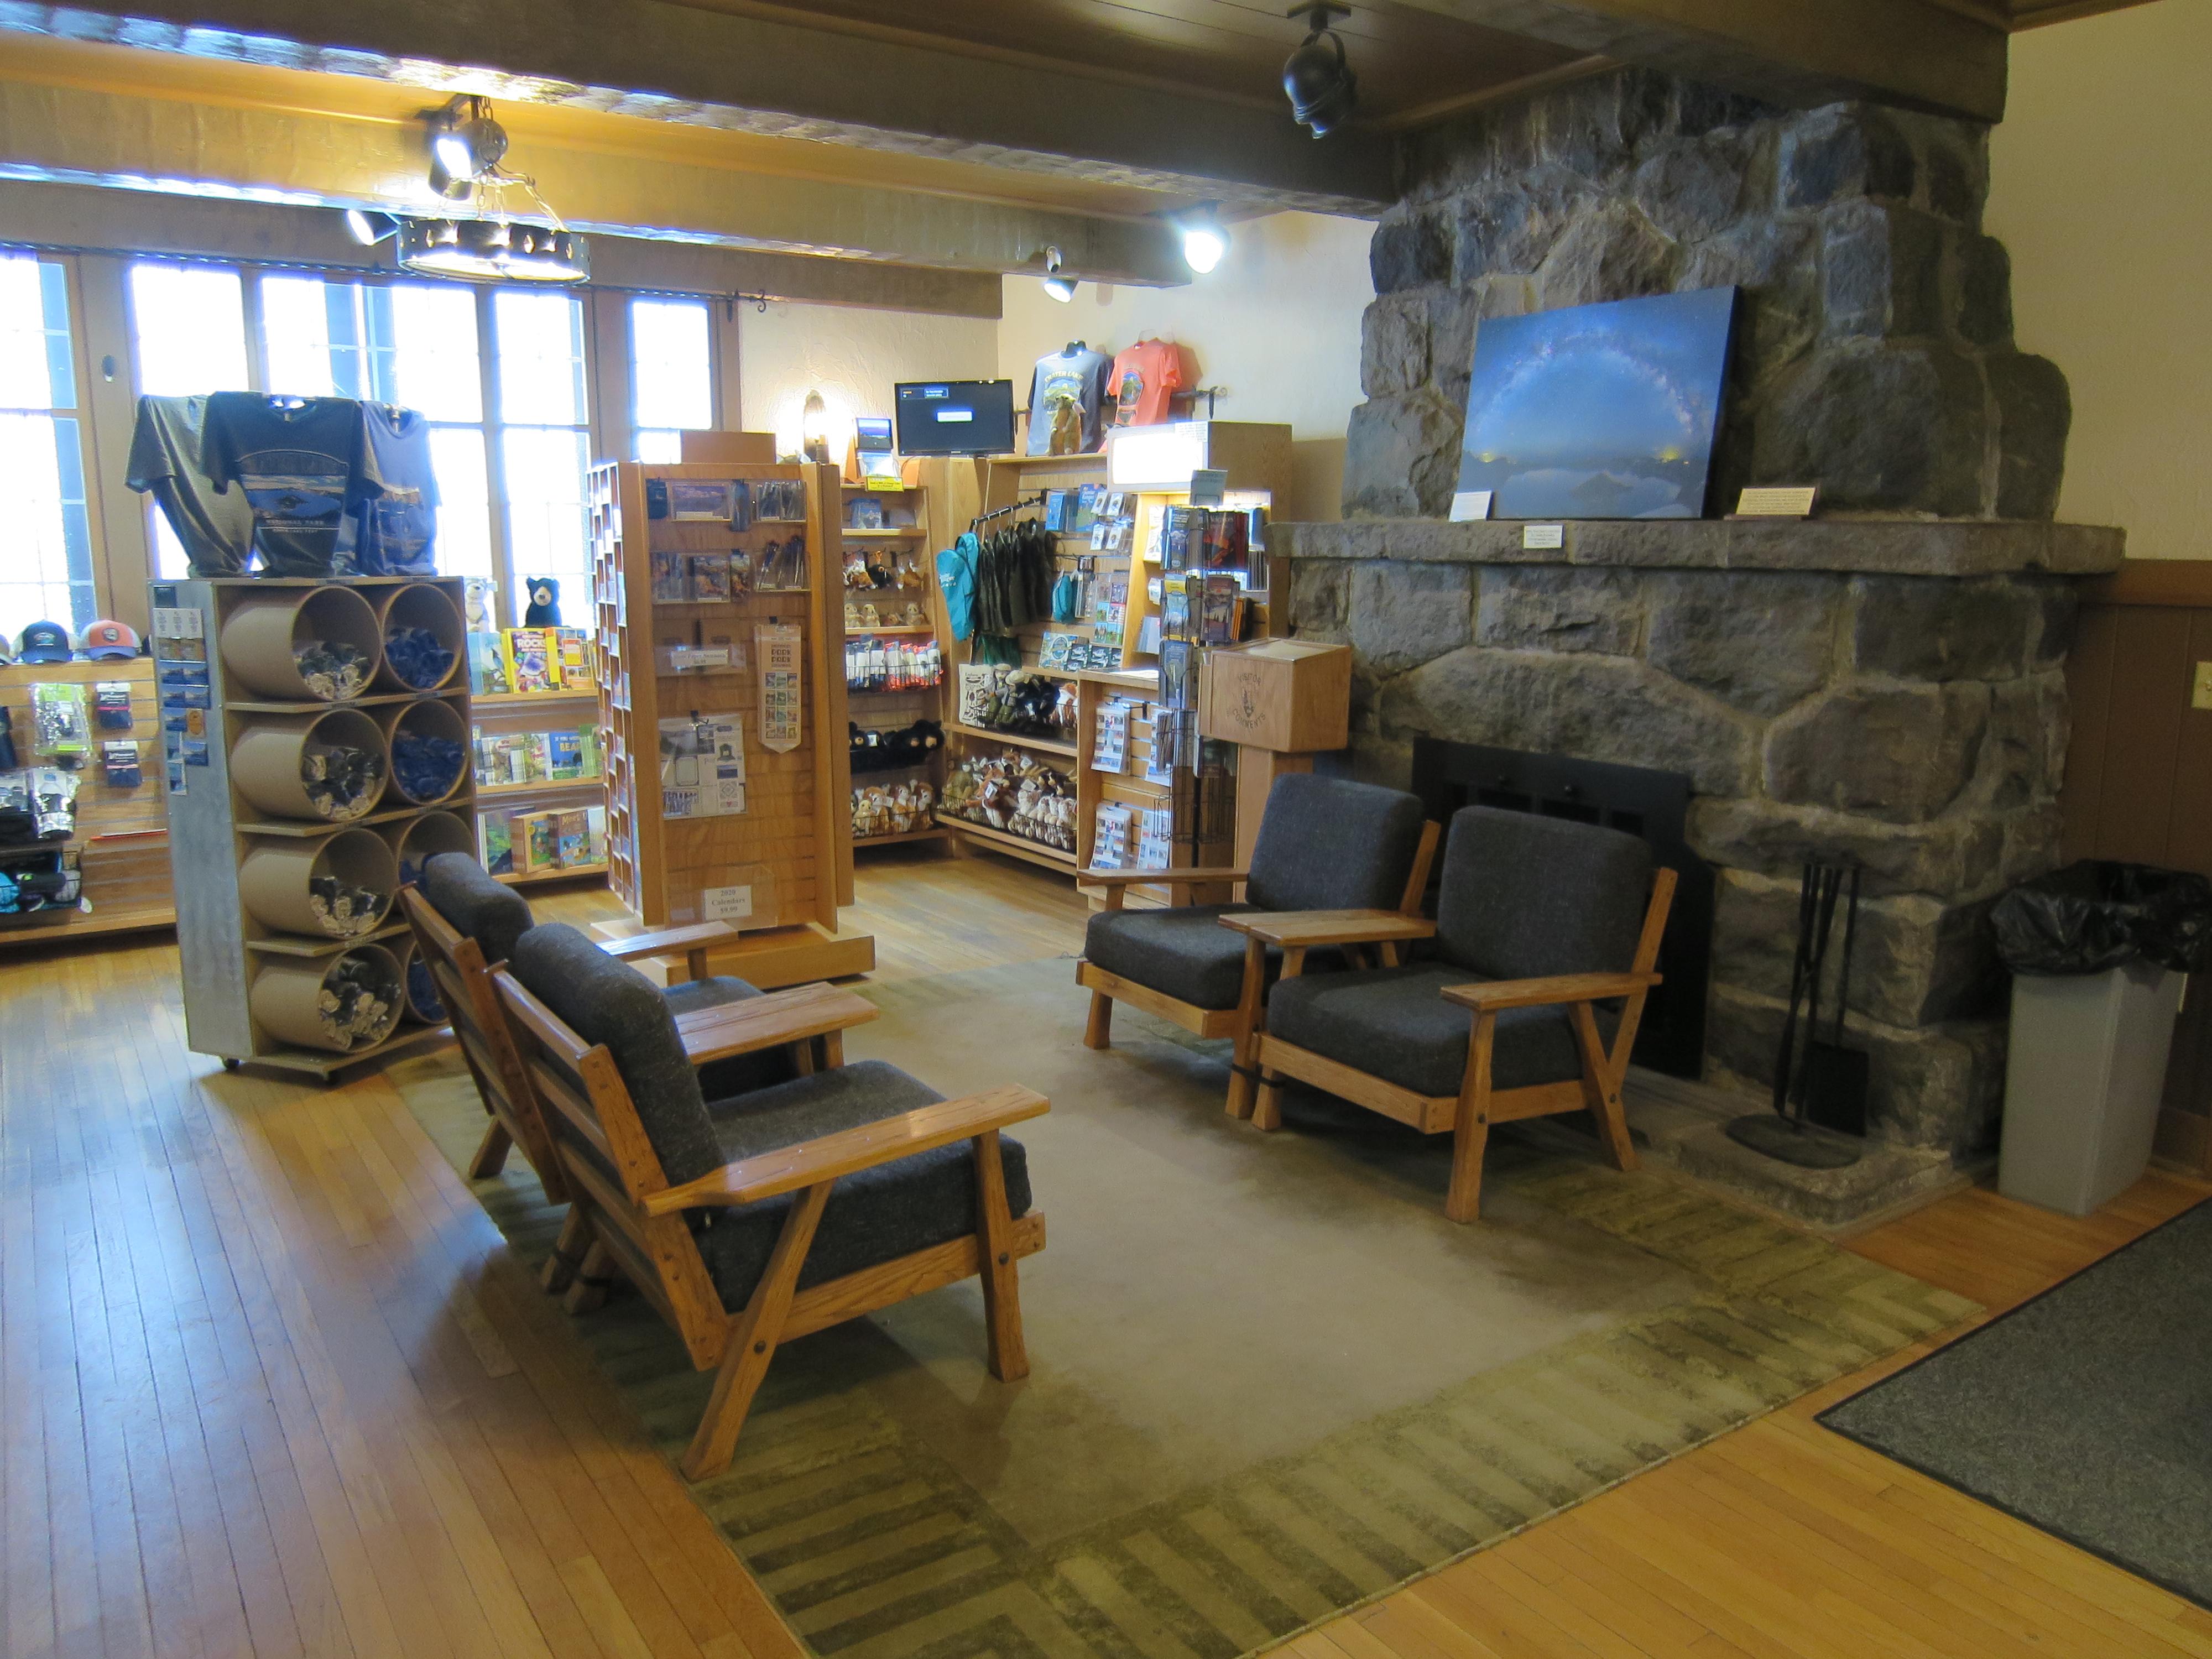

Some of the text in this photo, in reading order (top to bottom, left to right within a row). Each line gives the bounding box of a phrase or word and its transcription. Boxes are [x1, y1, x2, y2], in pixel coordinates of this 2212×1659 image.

[1045, 371, 1084, 383] CRATER LAKE
[1238, 672, 1261, 686] VISITOR
[1233, 709, 1266, 729] COMMENTS
